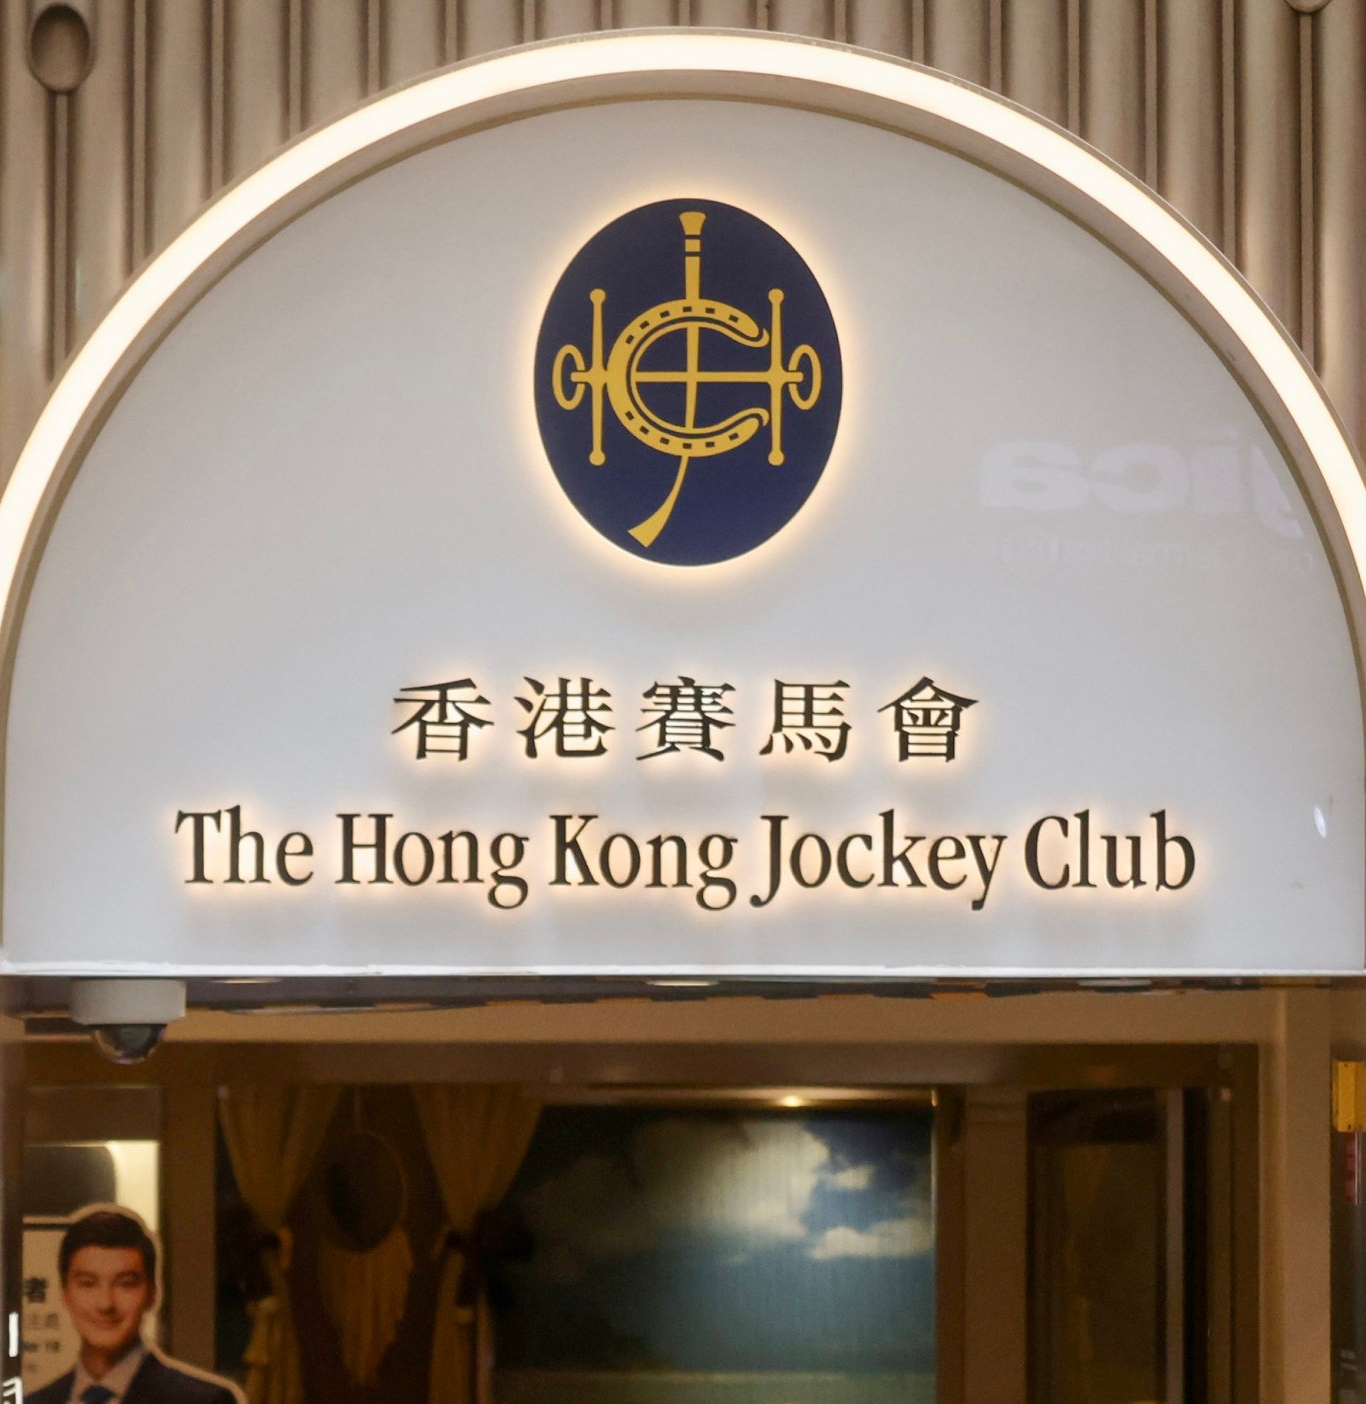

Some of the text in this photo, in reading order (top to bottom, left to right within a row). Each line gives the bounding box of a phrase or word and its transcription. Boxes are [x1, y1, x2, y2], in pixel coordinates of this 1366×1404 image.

[391, 675, 979, 762] 香港賽馬會
[174, 808, 1196, 911] The Hong Kong Jockey Club
